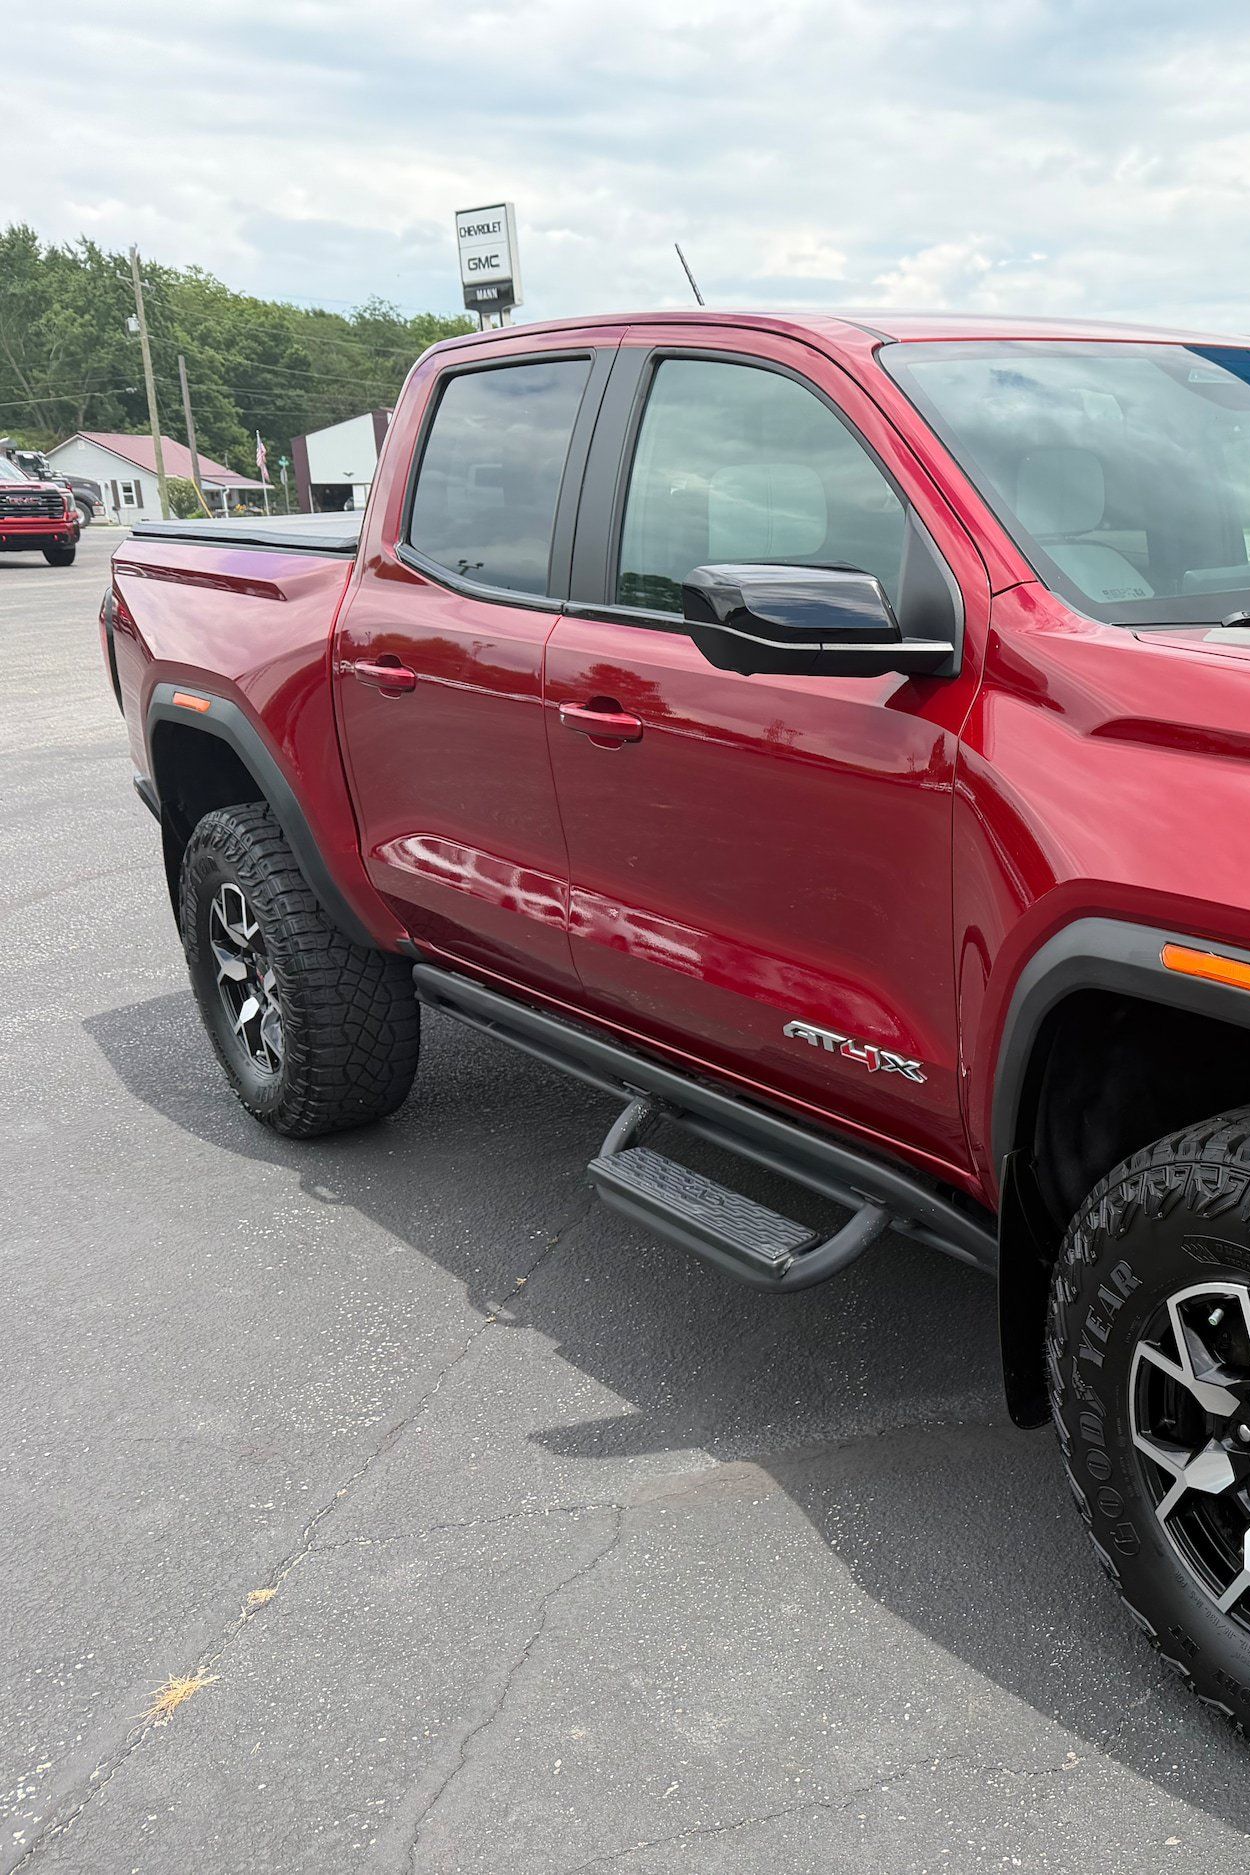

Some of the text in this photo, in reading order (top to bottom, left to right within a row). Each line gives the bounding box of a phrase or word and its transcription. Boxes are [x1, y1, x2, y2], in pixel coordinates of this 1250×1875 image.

[459, 221, 501, 238] CHEVROLET
[467, 254, 500, 271] GMC
[783, 1020, 928, 1084] AT4X
[1072, 1260, 1143, 1556] GOODYEAR
